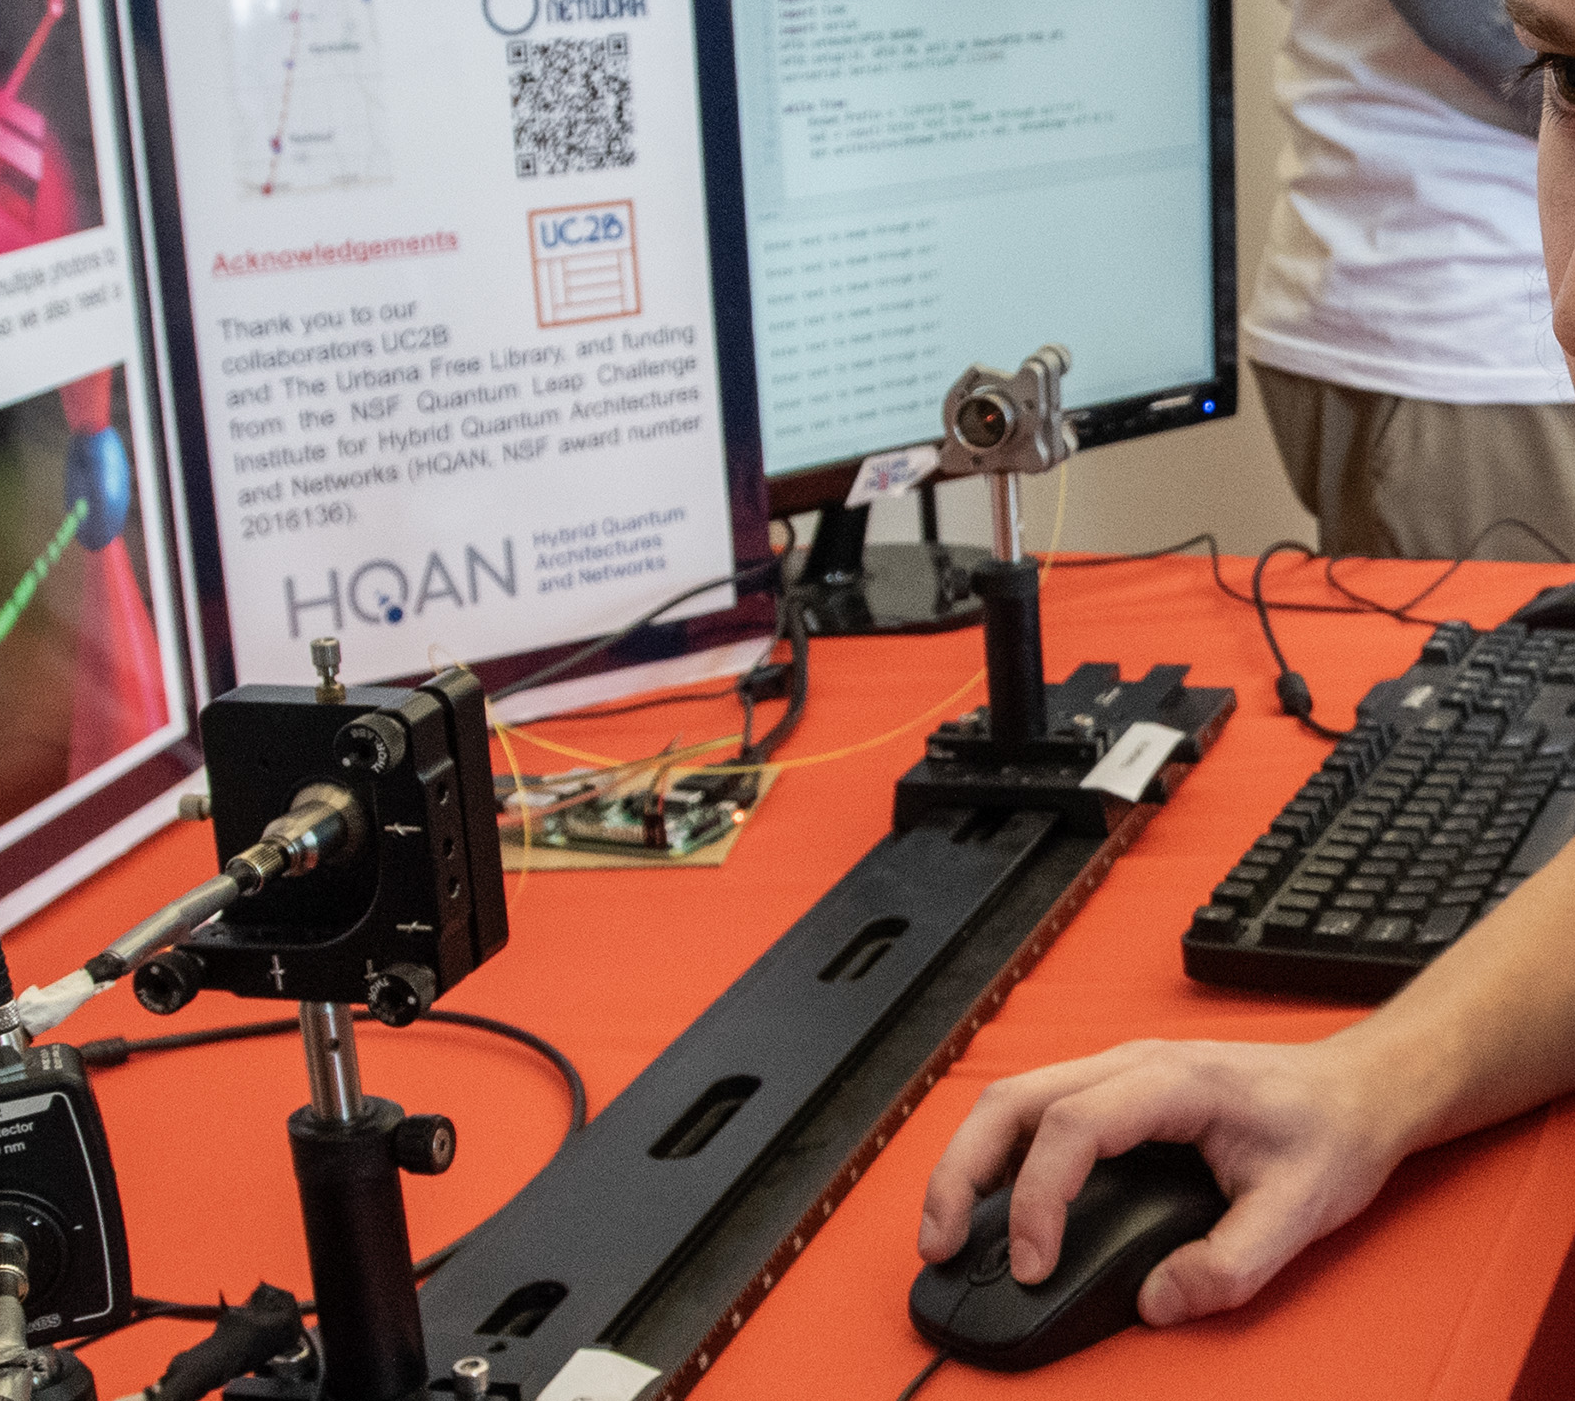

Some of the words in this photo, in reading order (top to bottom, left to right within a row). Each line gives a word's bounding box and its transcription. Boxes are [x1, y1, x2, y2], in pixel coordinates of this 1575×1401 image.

[210, 230, 458, 277] Acknowledgements
[540, 215, 624, 249] UC2B
[217, 313, 293, 341] Thank
[300, 311, 345, 336] you
[349, 306, 374, 325] to
[378, 300, 417, 322] our
[221, 338, 375, 375] collaborators
[380, 323, 450, 354] UC2B
[225, 382, 272, 409] and
[280, 375, 327, 398] The
[335, 364, 422, 393] Urbana
[429, 355, 482, 378] Free
[575, 334, 614, 358] and
[621, 324, 697, 350] funding
[228, 416, 284, 439] from
[298, 409, 336, 430] the
[349, 393, 400, 422] NSF
[415, 382, 519, 414] Quantum
[531, 373, 585, 396] Leap
[596, 354, 698, 385] Challenge
[233, 443, 327, 473] Institute
[336, 435, 367, 457] for
[377, 421, 452, 453] Hybrid
[460, 408, 561, 439] Quantum
[569, 385, 701, 420] Architectures
[237, 480, 283, 507] and
[290, 464, 400, 496] Networks
[501, 435, 547, 462] NSF
[558, 426, 620, 454] award
[627, 414, 702, 440] number
[531, 521, 598, 548] Hybrid
[601, 506, 686, 537] Quantum
[534, 534, 663, 570] Architectures
[537, 571, 574, 594] and
[578, 556, 667, 584] Networks
[285, 538, 517, 639] HQAN
[3, 1141, 26, 1152] nm
